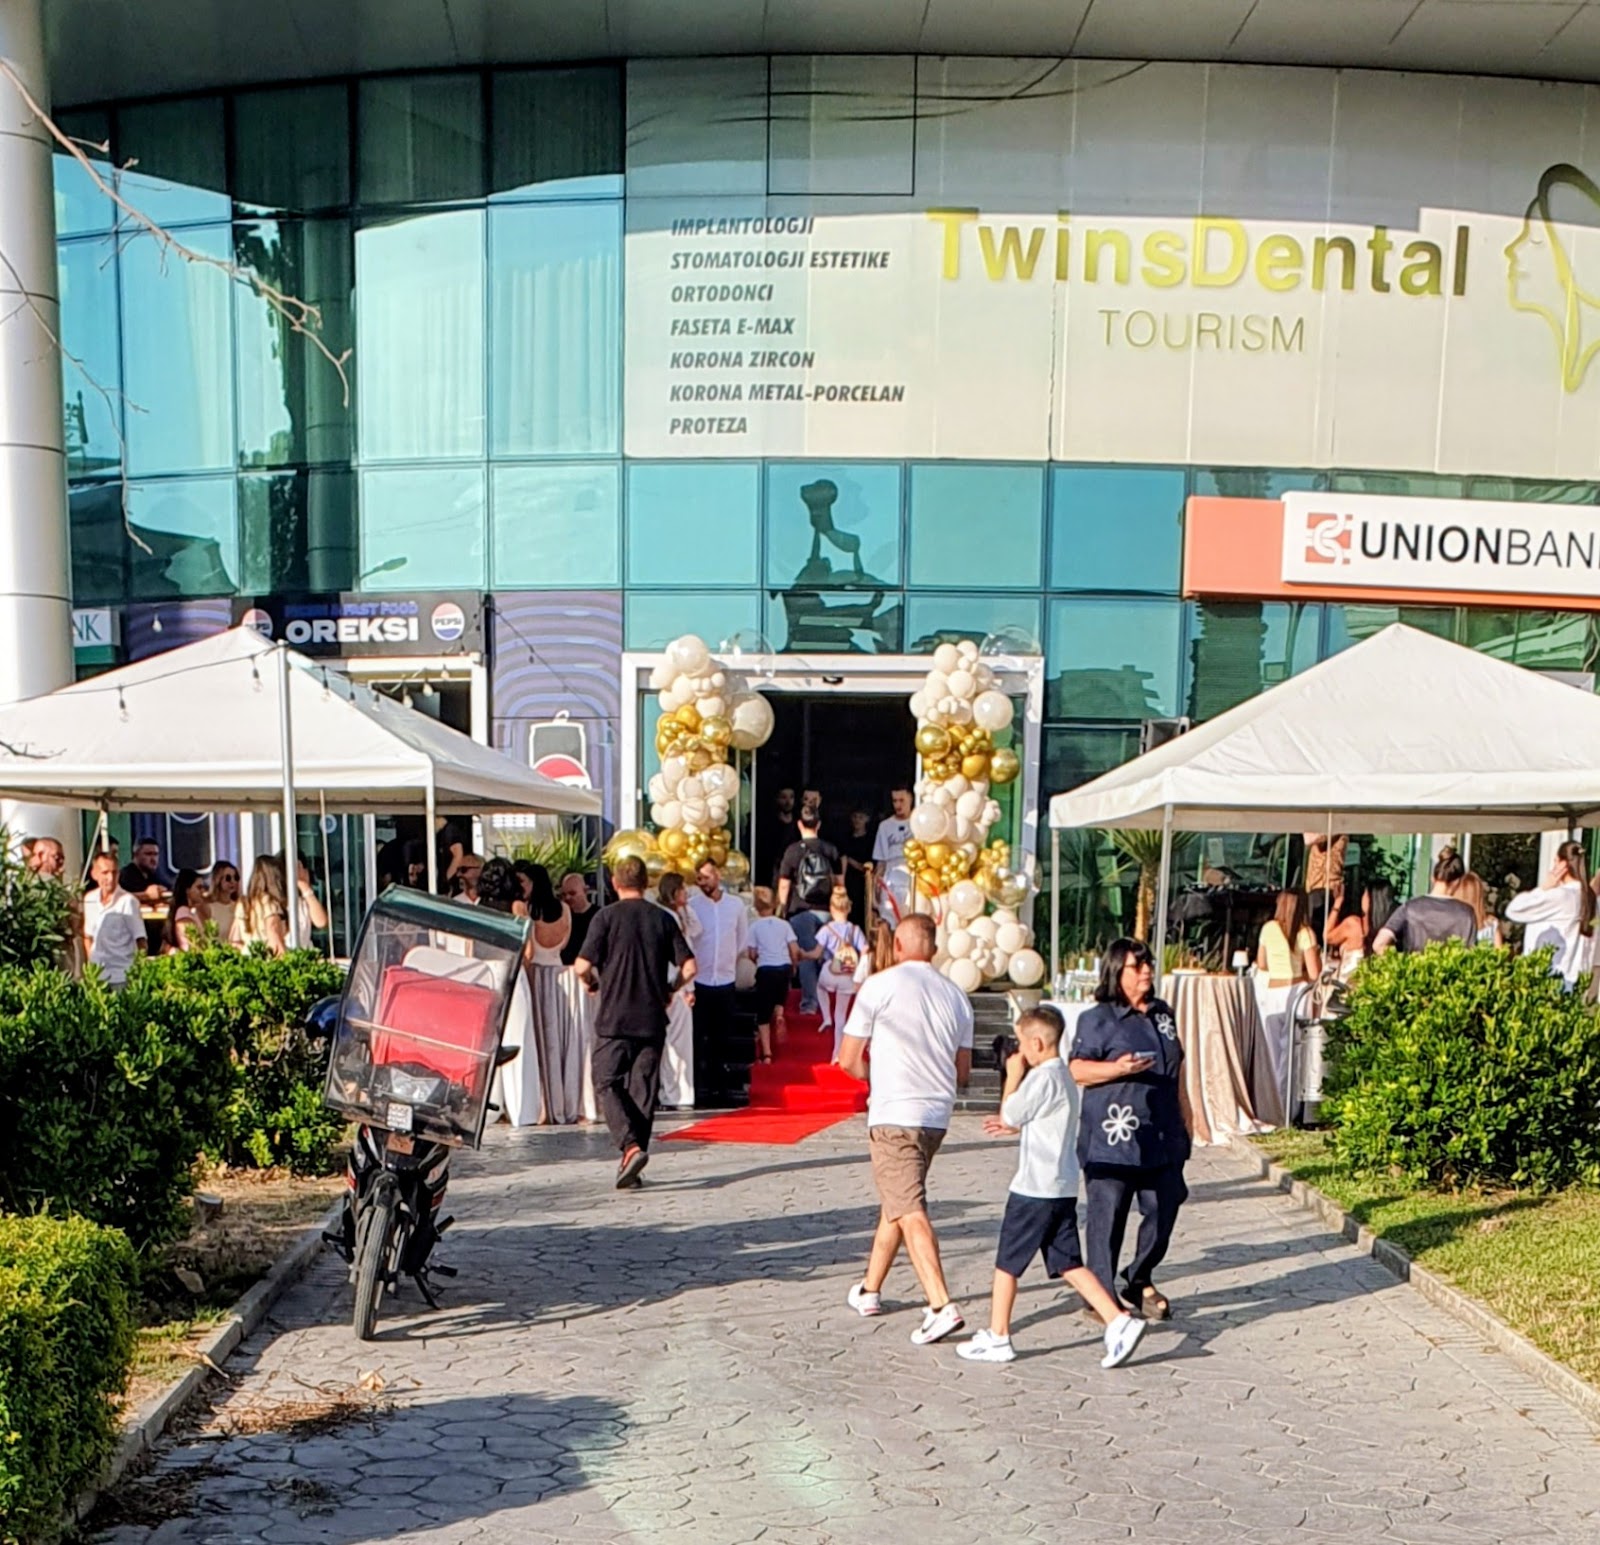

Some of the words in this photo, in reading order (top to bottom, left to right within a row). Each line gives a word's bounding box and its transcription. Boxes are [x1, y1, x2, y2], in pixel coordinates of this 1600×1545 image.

[671, 217, 815, 236] IMPLANTOLOGJI
[670, 251, 804, 269] STOMATOLOGJI
[809, 251, 890, 268] ESTETIKE
[925, 207, 1469, 296] TwinsDental
[671, 284, 774, 302] ORTODONCI
[670, 319, 731, 336] FASETA
[737, 318, 796, 335] E-MAX
[1098, 309, 1304, 353] TOURISM
[669, 351, 744, 369] KORONA
[748, 351, 815, 369] ZIRCON
[669, 384, 743, 402] KORONA
[748, 384, 905, 402] METAL-PORCELAN
[669, 417, 748, 434] PROTEZA
[1359, 520, 1600, 570] UNIONBAN
[380, 601, 419, 615] FOOD
[285, 616, 419, 644] OREKSI
